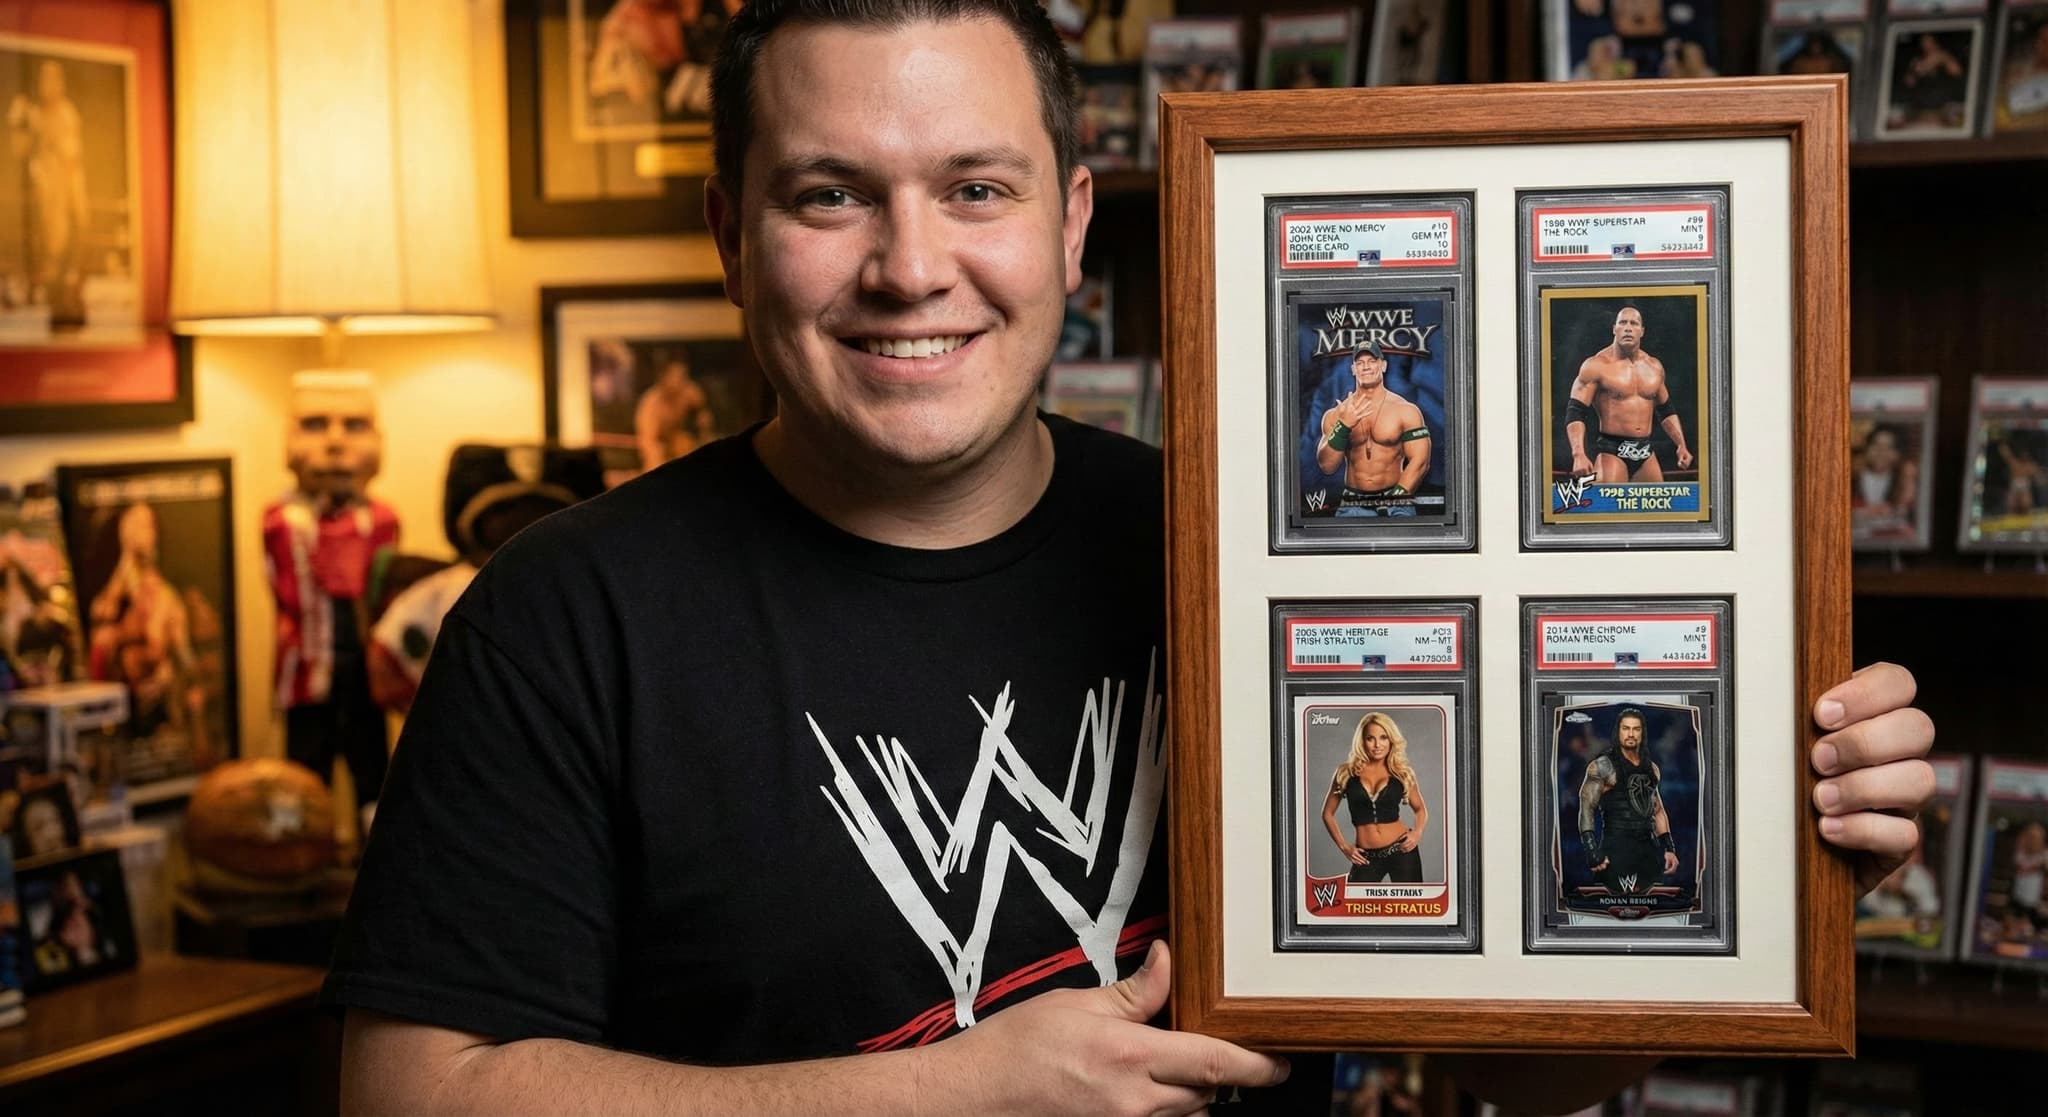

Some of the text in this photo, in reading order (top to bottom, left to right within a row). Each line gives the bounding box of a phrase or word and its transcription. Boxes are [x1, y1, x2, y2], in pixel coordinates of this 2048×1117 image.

[1568, 219, 1590, 227] WWF
[1594, 217, 1646, 226] SUPERSTAR
[1289, 224, 1386, 234] 2002 WWE NO MERCY
[1544, 228, 1588, 236] THE ROCK
[1681, 224, 1703, 232] MINT
[1289, 234, 1340, 243] JOHN CENA
[1411, 231, 1447, 240] GEM MT
[1698, 233, 1704, 241] 9
[1289, 243, 1350, 252] ROOKIE CARD
[1438, 240, 1448, 248] 10
[1347, 308, 1414, 329] WWE
[1312, 324, 1439, 356] MERCY
[1628, 486, 1691, 497] SUPERSTAR
[1616, 497, 1672, 510] THE ROCK
[1320, 628, 1343, 636] WWE
[1345, 628, 1389, 637] HERITAGE
[1546, 625, 1636, 634] 2014 WWE CHROME
[1296, 637, 1365, 645] TRISH STRATUS
[1546, 635, 1616, 643] ROMAN REIGNS
[1684, 634, 1706, 642] MINT
[1701, 643, 1707, 651] 9
[1345, 903, 1442, 914] TRISH STRATUS
